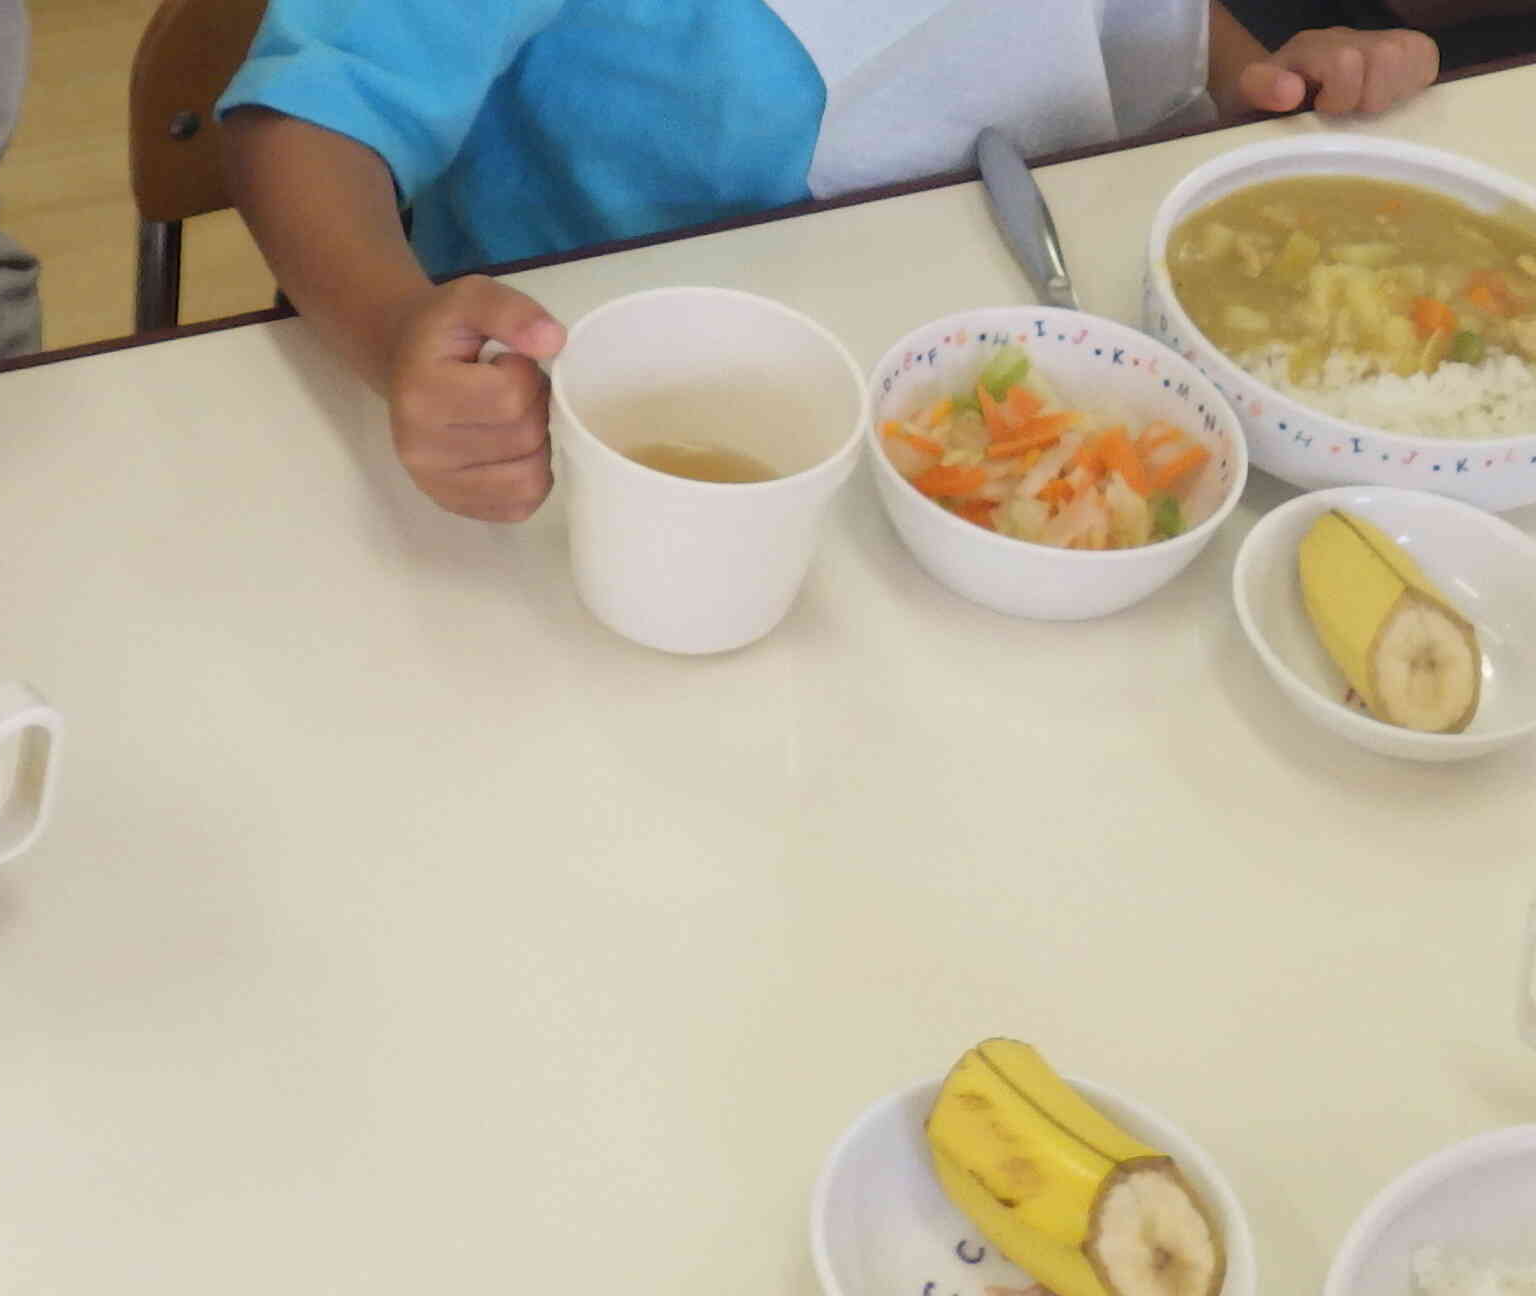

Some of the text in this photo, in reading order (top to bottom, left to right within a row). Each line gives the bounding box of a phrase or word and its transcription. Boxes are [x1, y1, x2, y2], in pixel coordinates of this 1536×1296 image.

[1033, 319, 1047, 337] I
[1112, 347, 1125, 365] K
[1349, 436, 1365, 454] I
